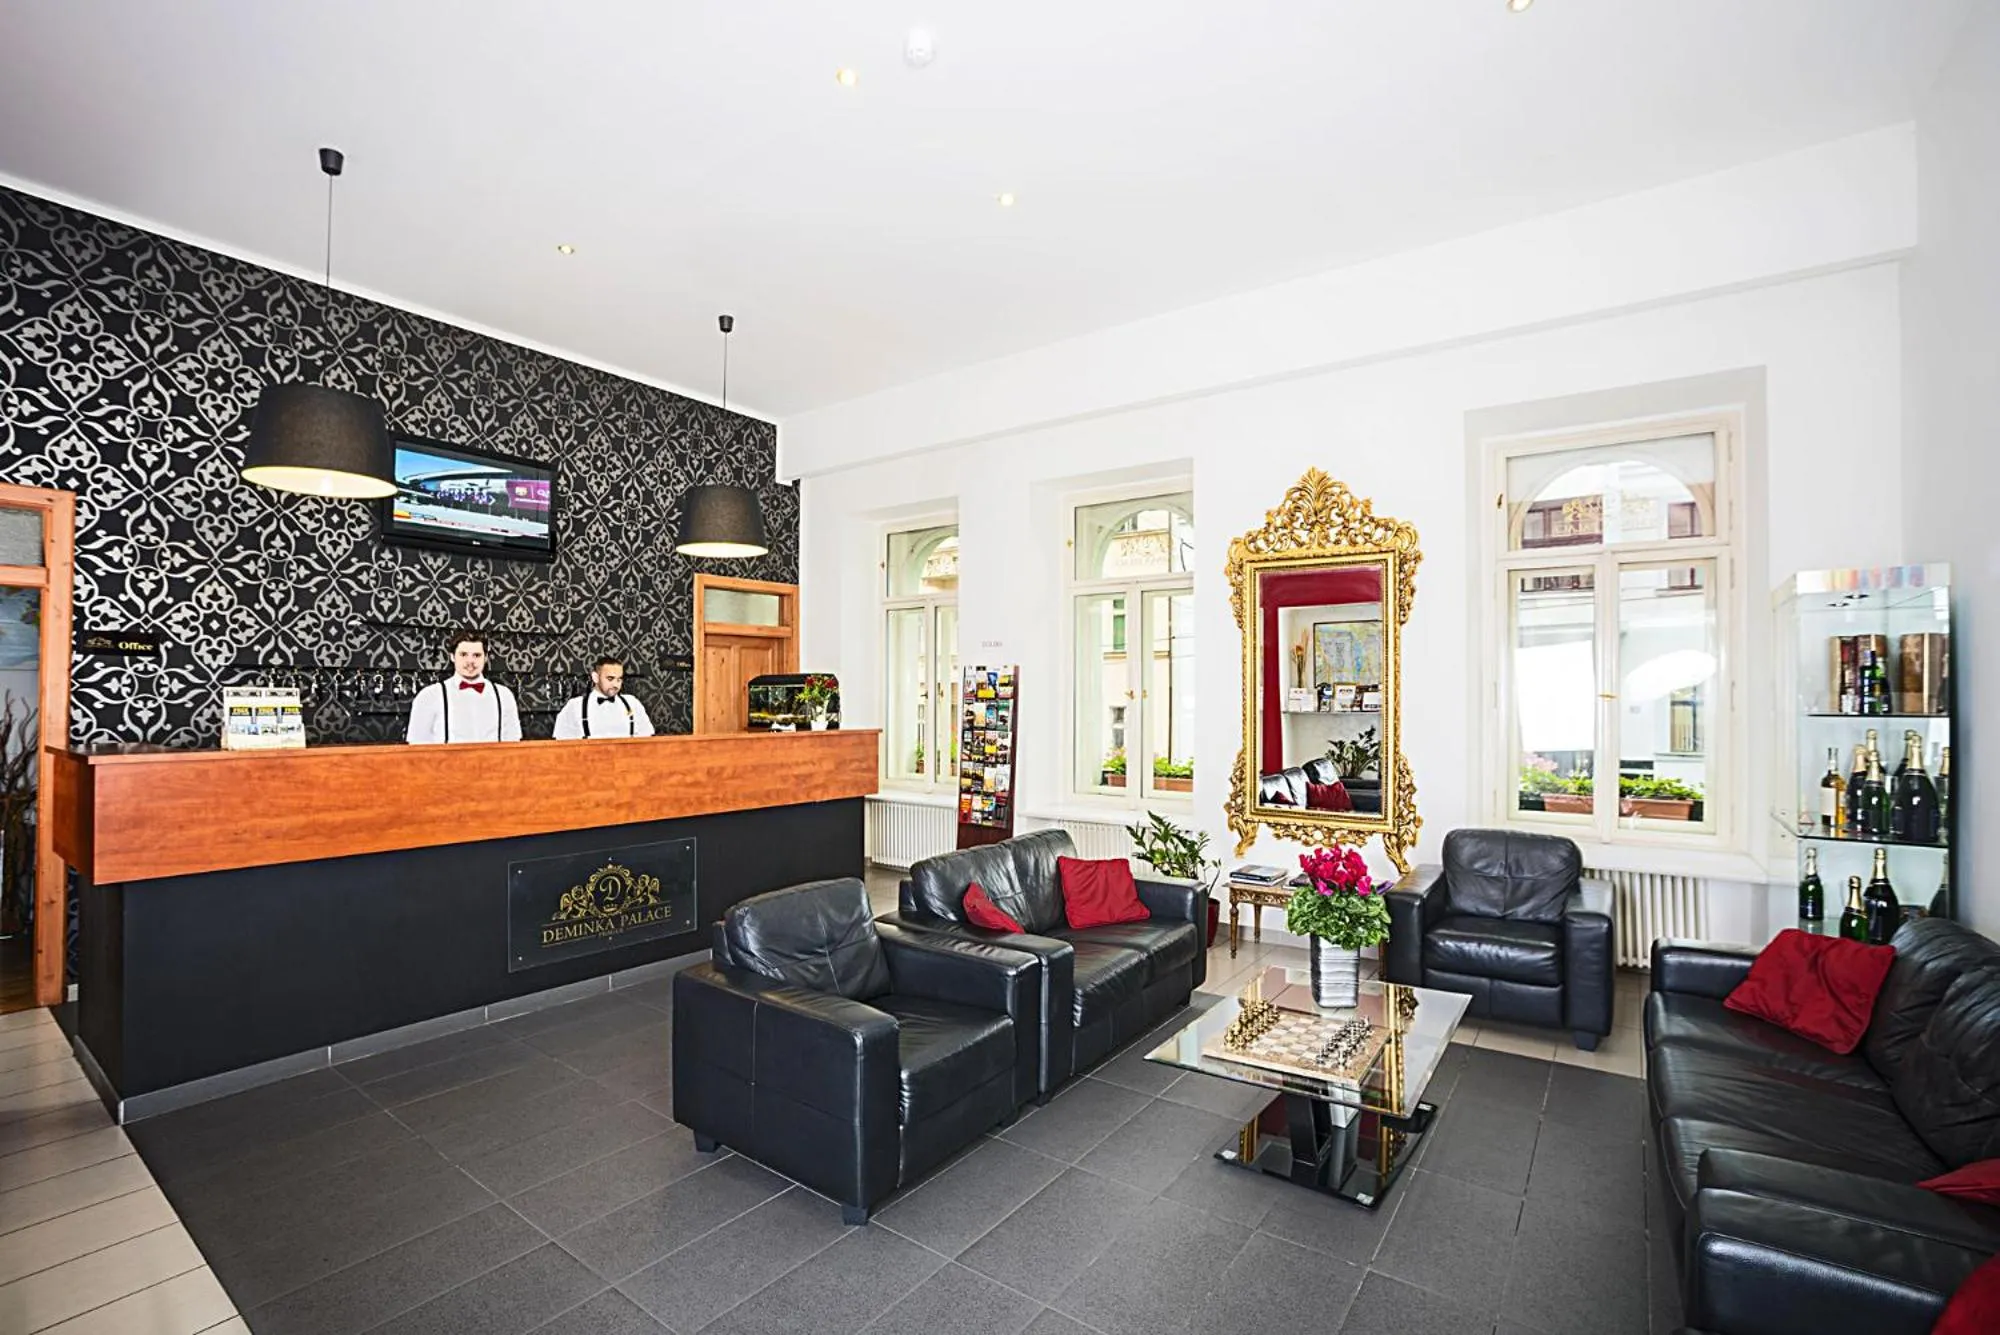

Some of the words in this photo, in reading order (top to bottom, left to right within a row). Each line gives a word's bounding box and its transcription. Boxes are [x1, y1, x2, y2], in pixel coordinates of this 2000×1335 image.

[118, 641, 153, 651] Office
[599, 875, 622, 901] D
[542, 917, 615, 943] DEMINKA
[620, 905, 672, 926] PALACE
